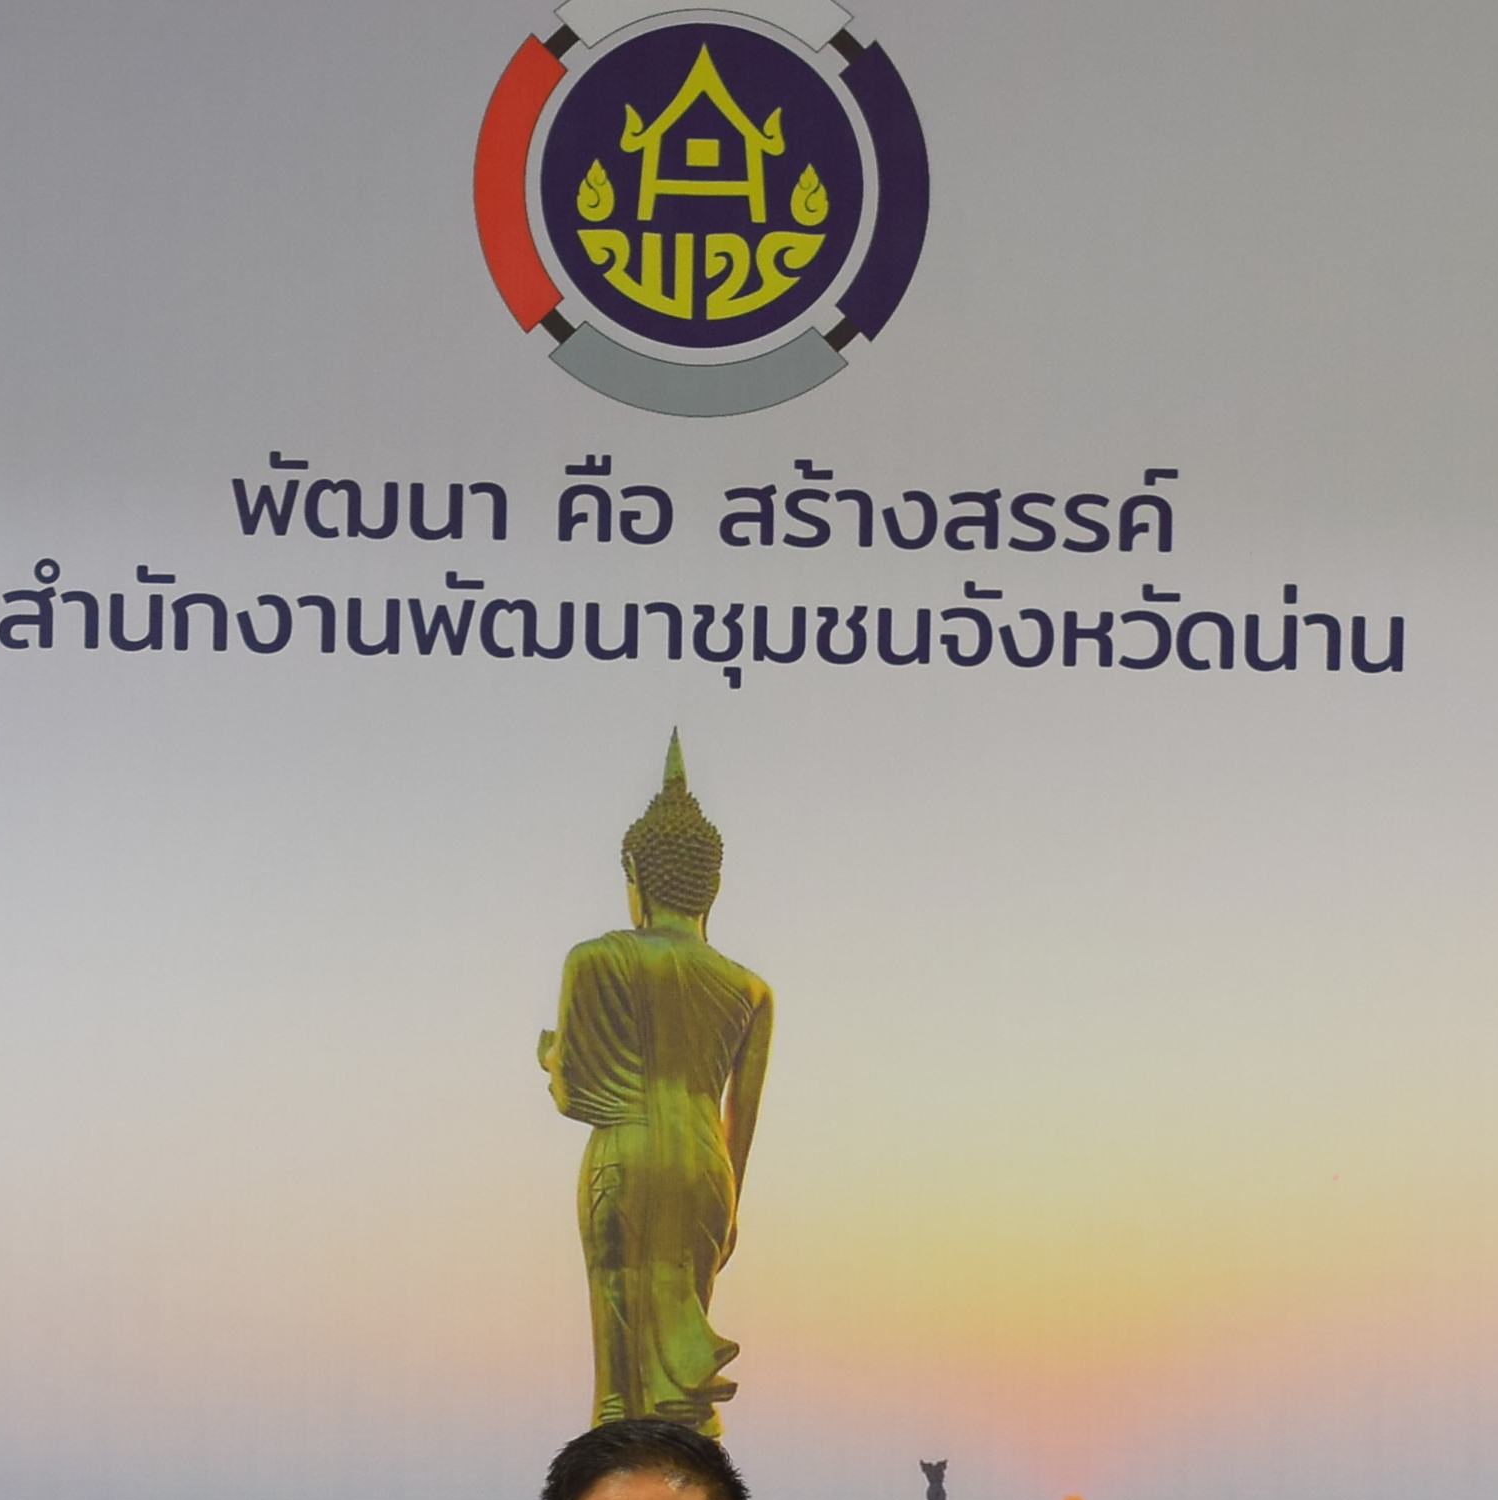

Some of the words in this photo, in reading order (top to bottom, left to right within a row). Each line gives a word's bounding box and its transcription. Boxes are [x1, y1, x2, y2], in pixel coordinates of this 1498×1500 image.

[231, 450, 508, 541] พัฒนา
[558, 454, 674, 545] คือ
[719, 459, 1180, 553] สร้างสรรค์
